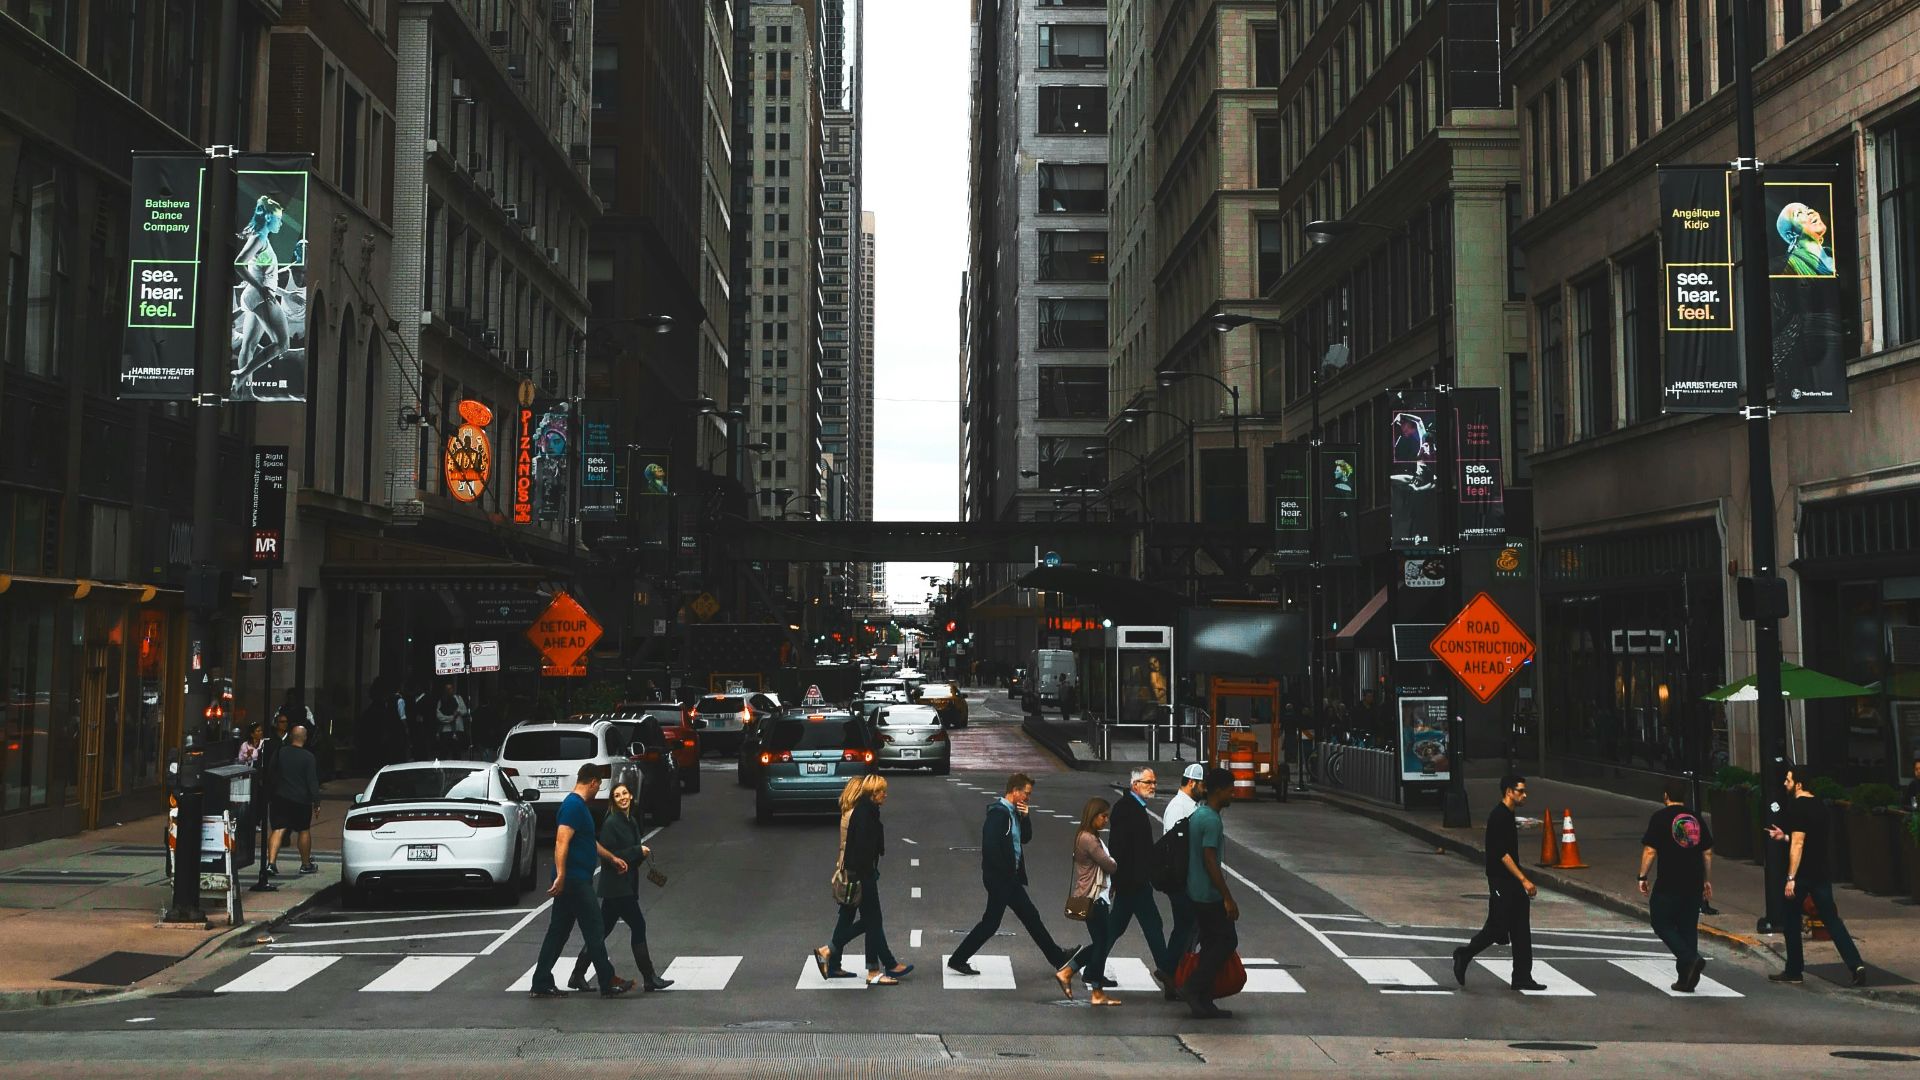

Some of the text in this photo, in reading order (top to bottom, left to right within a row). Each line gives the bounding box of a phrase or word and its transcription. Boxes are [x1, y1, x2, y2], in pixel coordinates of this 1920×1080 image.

[145, 199, 190, 208] Batsheva
[151, 211, 183, 220] Dance
[1672, 208, 1721, 219] Angélique
[143, 222, 190, 233] Company
[1684, 220, 1710, 231] Kidjo
[141, 269, 178, 283] see.
[1677, 272, 1713, 286] see.
[140, 284, 184, 300] hear.
[1677, 286, 1720, 303] hear.
[139, 301, 177, 317] feel.
[1677, 304, 1715, 320] feel.
[132, 367, 195, 376] HARRIS THEATER
[1675, 381, 1738, 389] HARRIS THEATER
[265, 453, 283, 461] Right
[587, 465, 609, 473] hear.
[1465, 465, 1490, 474] see.
[1466, 474, 1494, 485] hear.
[1466, 486, 1491, 496] feel.
[1281, 508, 1303, 517] hear.
[255, 537, 277, 553] MR
[540, 620, 587, 633] DETOUR
[1467, 621, 1500, 634] ROAD
[543, 637, 586, 649] AHEAD
[1440, 640, 1527, 654] CONSTRUCTION
[1464, 661, 1505, 675] AHEAD
